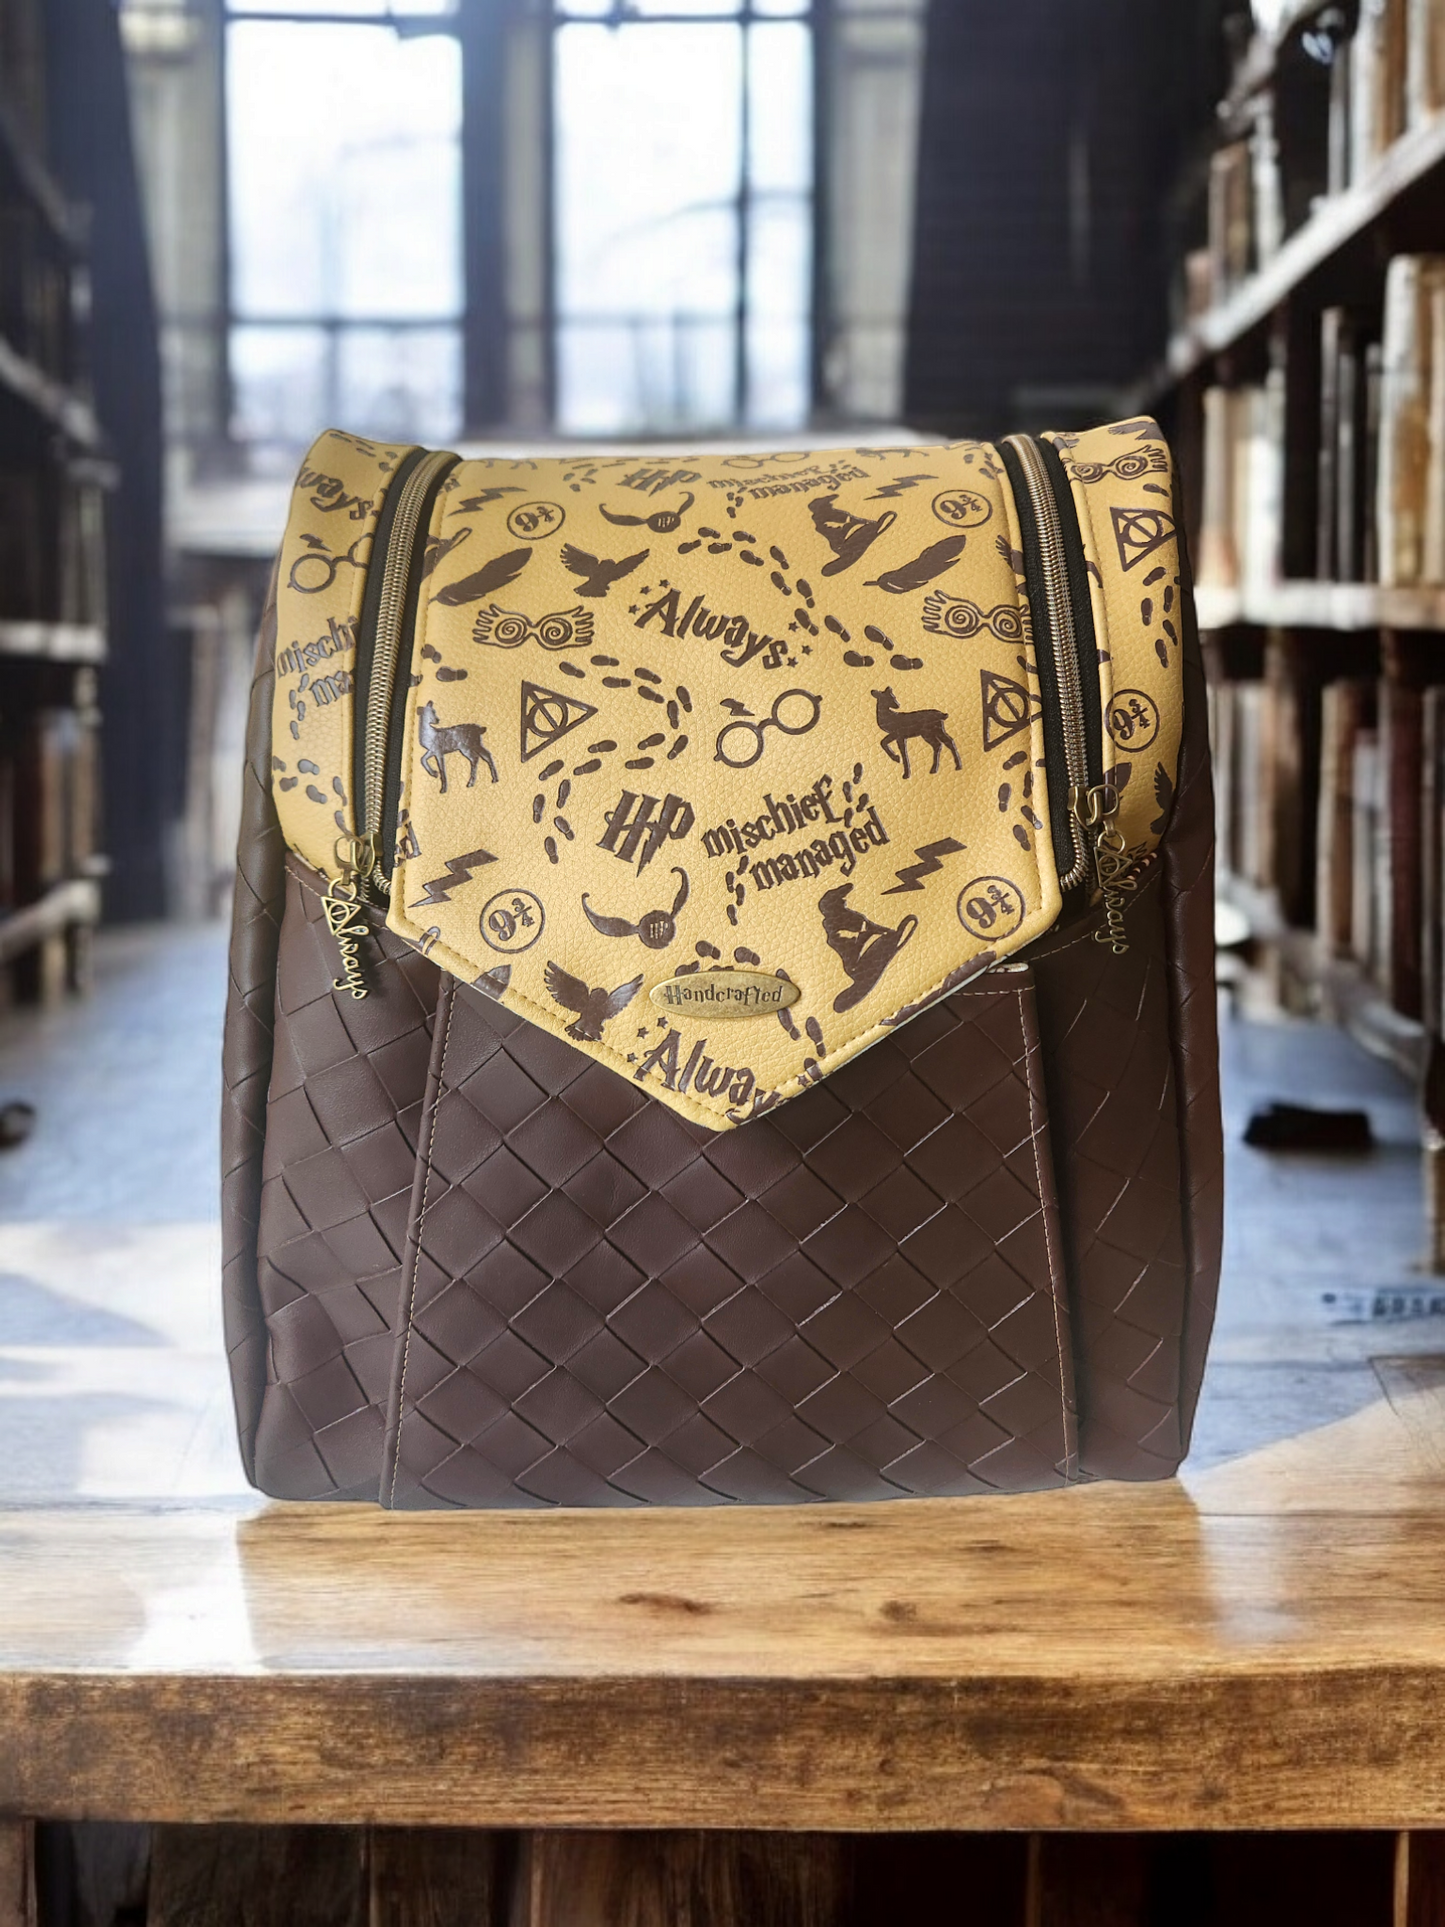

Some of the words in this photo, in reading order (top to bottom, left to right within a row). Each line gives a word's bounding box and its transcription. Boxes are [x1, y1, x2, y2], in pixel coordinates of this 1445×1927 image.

[633, 587, 789, 670] Always
[700, 774, 844, 859] mischief
[749, 805, 891, 892] managed
[664, 983, 783, 1006] Handcrafted
